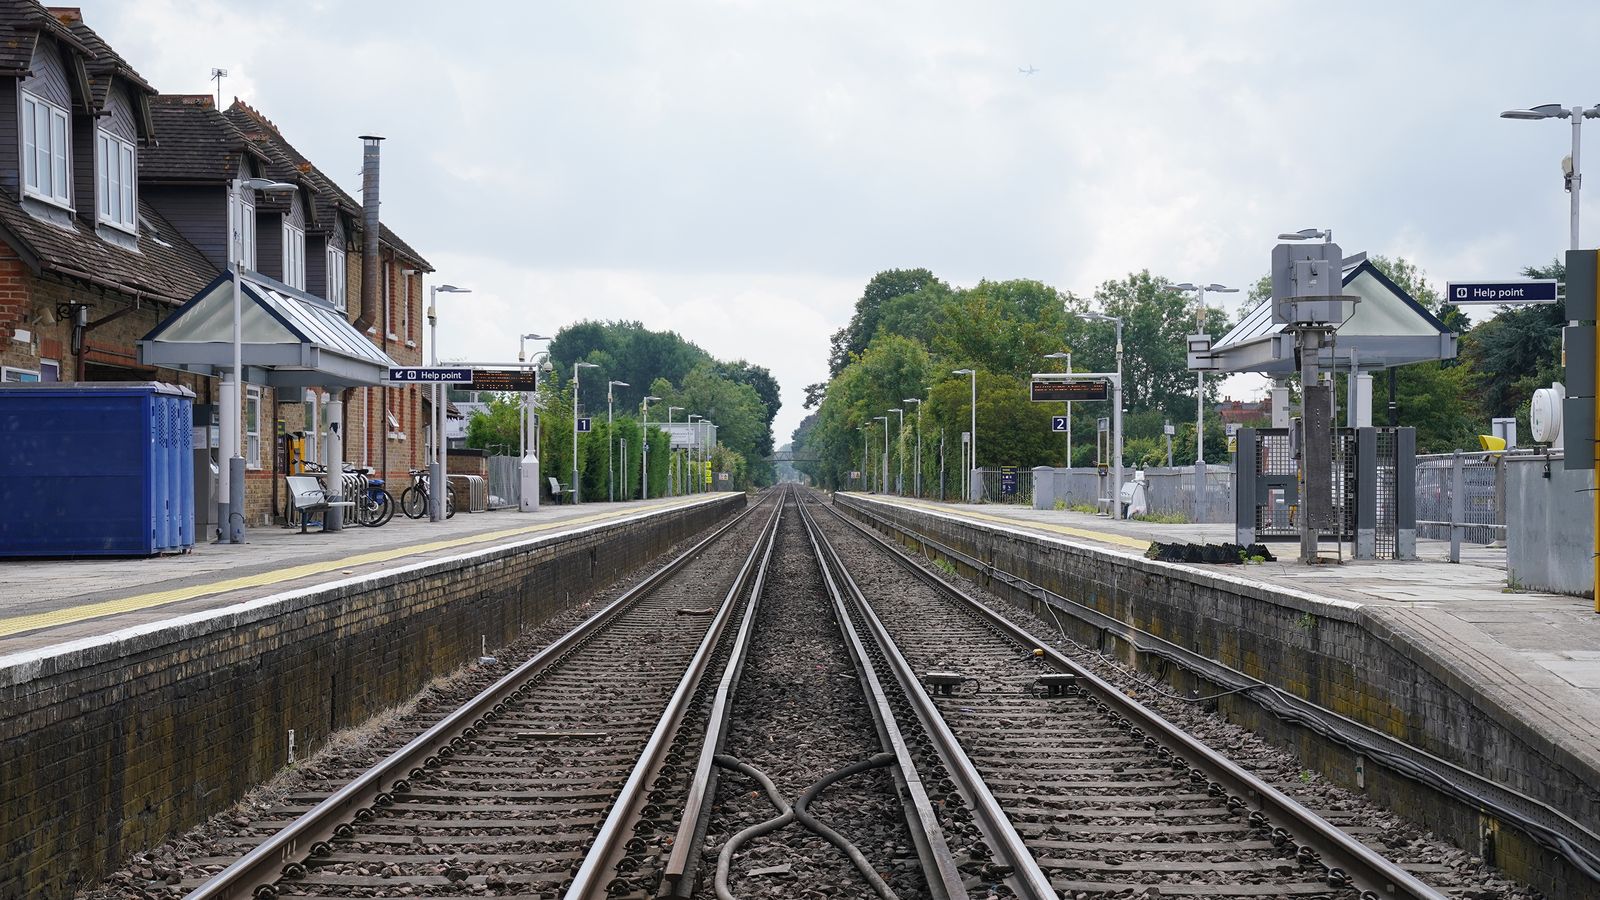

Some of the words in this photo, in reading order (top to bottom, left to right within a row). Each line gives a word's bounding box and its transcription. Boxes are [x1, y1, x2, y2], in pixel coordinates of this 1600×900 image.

[1473, 288, 1496, 298] Help
[1499, 288, 1524, 299] point
[421, 371, 440, 380] Help
[441, 371, 462, 380] point
[581, 420, 586, 430] 1
[1057, 419, 1064, 430] 2
